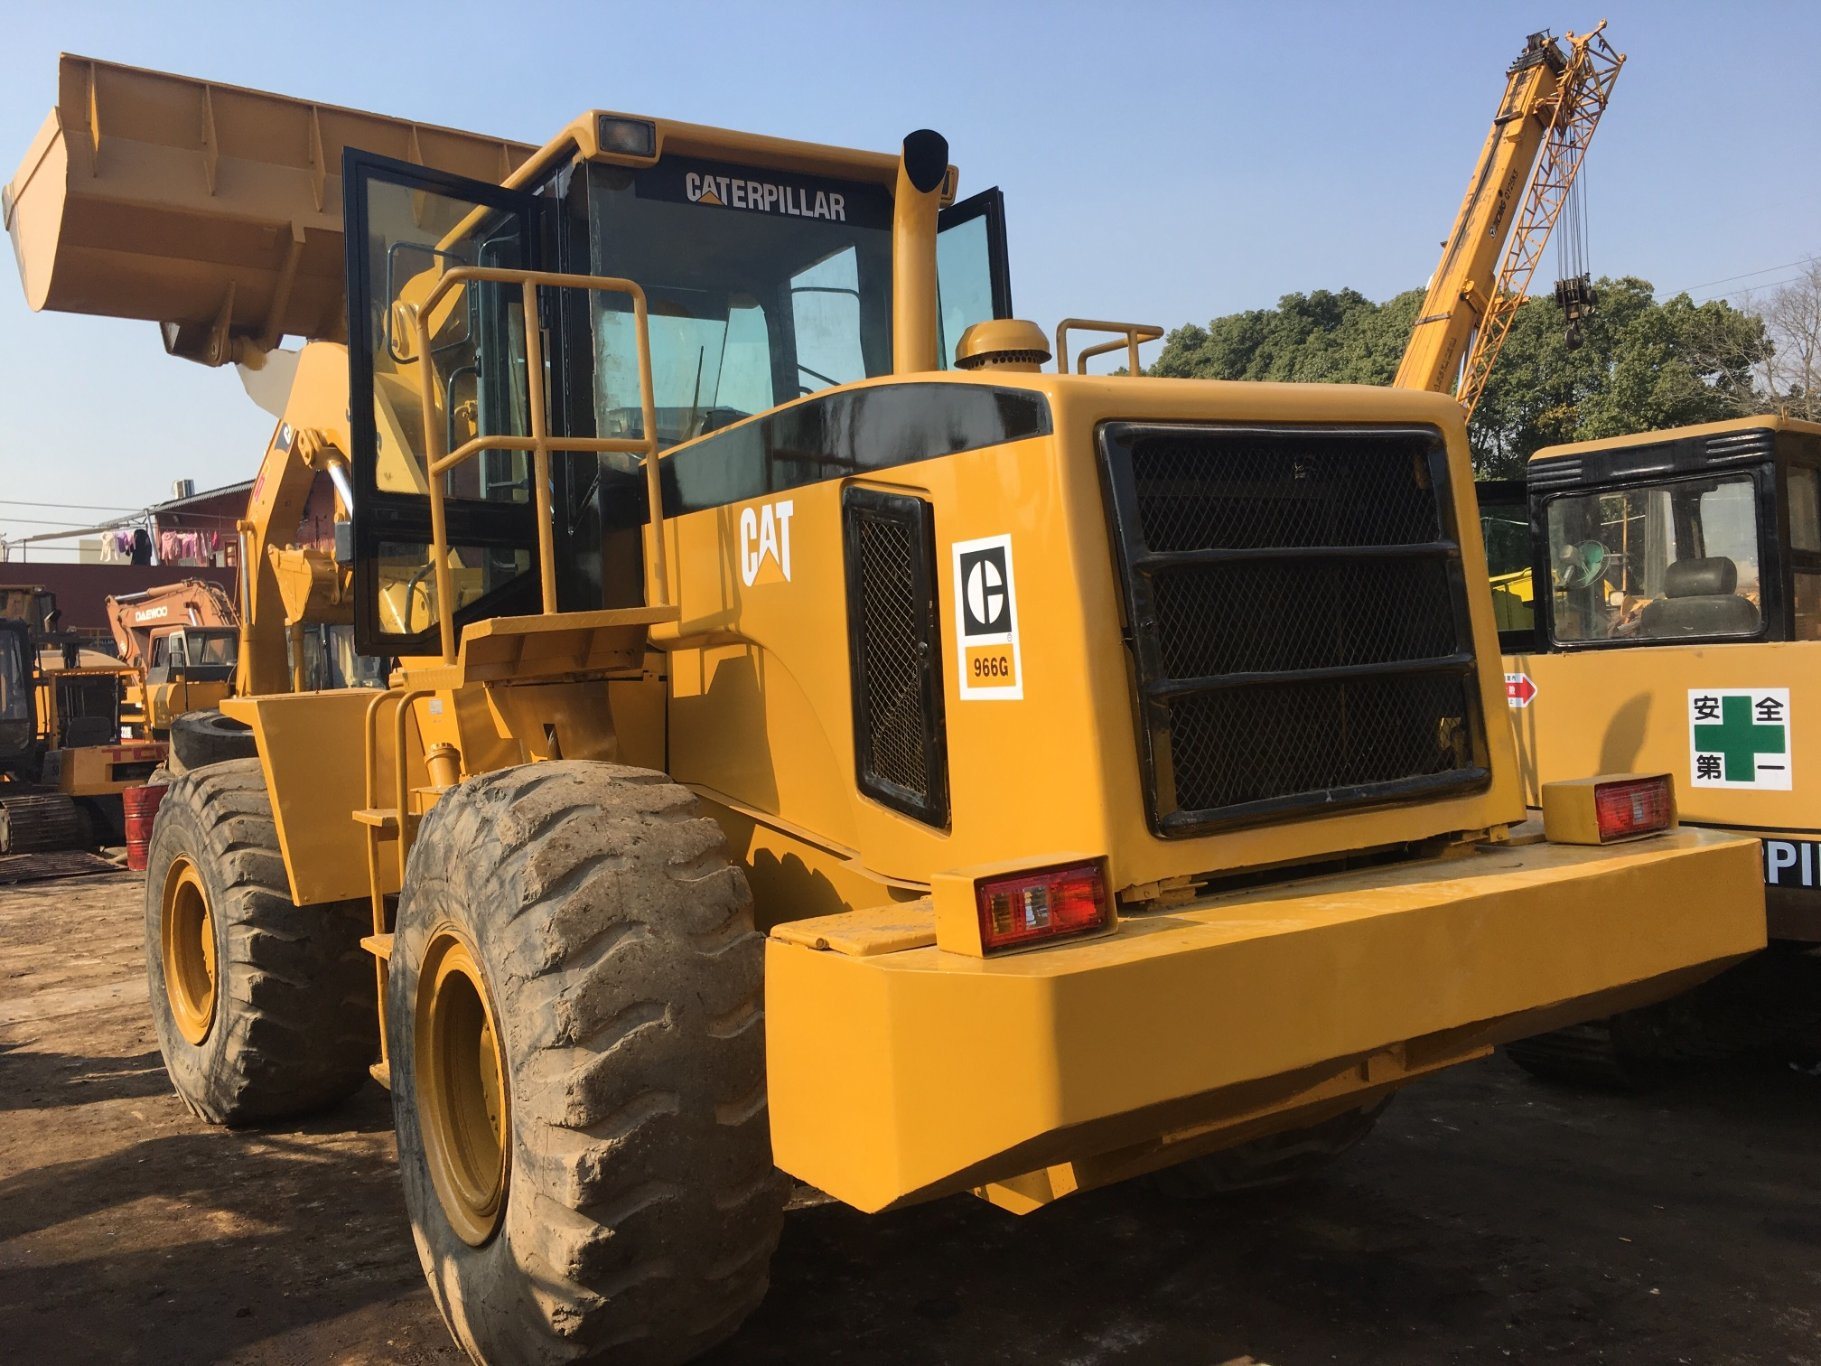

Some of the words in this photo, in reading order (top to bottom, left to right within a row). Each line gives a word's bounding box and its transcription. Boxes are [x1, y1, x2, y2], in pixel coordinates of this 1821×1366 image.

[685, 171, 847, 222] CATERPILLAR
[740, 500, 794, 587] CAT
[135, 606, 168, 622] DAEWOO
[973, 655, 1009, 678] 966G
